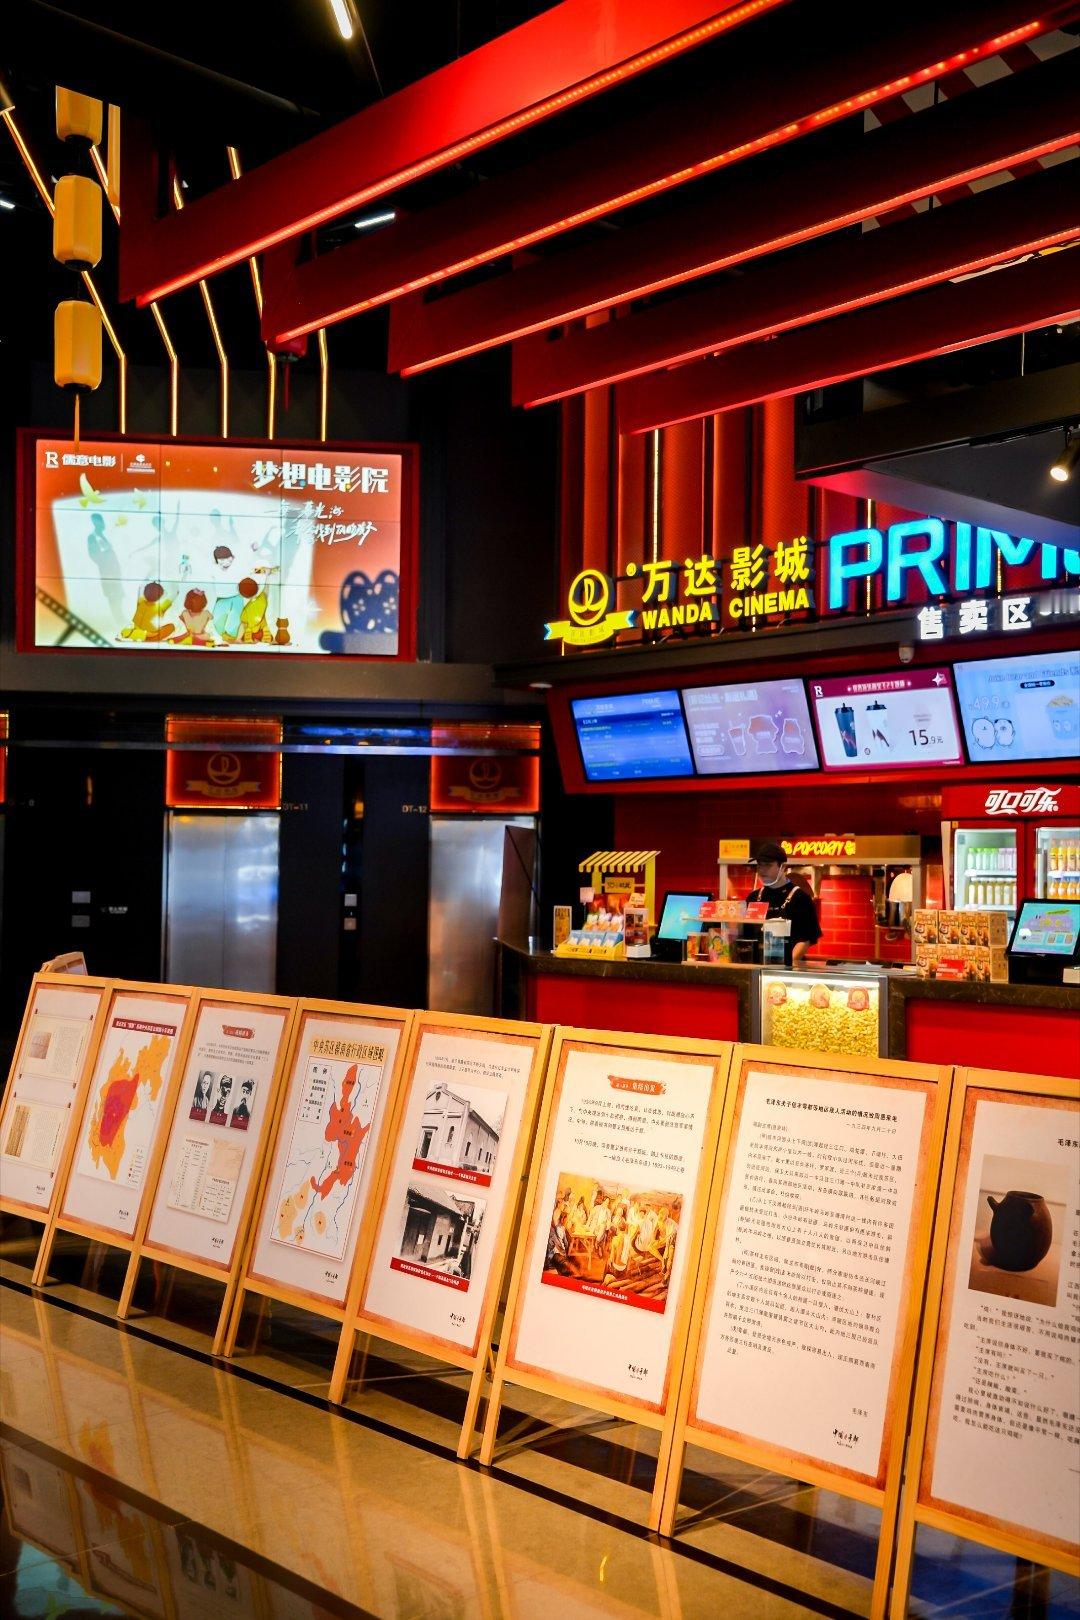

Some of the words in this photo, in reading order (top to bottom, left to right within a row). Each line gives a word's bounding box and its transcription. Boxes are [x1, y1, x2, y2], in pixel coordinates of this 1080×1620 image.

[251, 460, 388, 493] 梦想电影院
[642, 536, 809, 603] 万达影城
[829, 518, 1080, 610] PRIM
[642, 602, 713, 630] WANDA
[729, 588, 810, 619] CINEMA
[917, 597, 1032, 640] 售卖区
[402, 805, 428, 813] DT-12
[985, 787, 1061, 815] 可口可乐
[1057, 1138, 1080, 1148] 毛泽东
